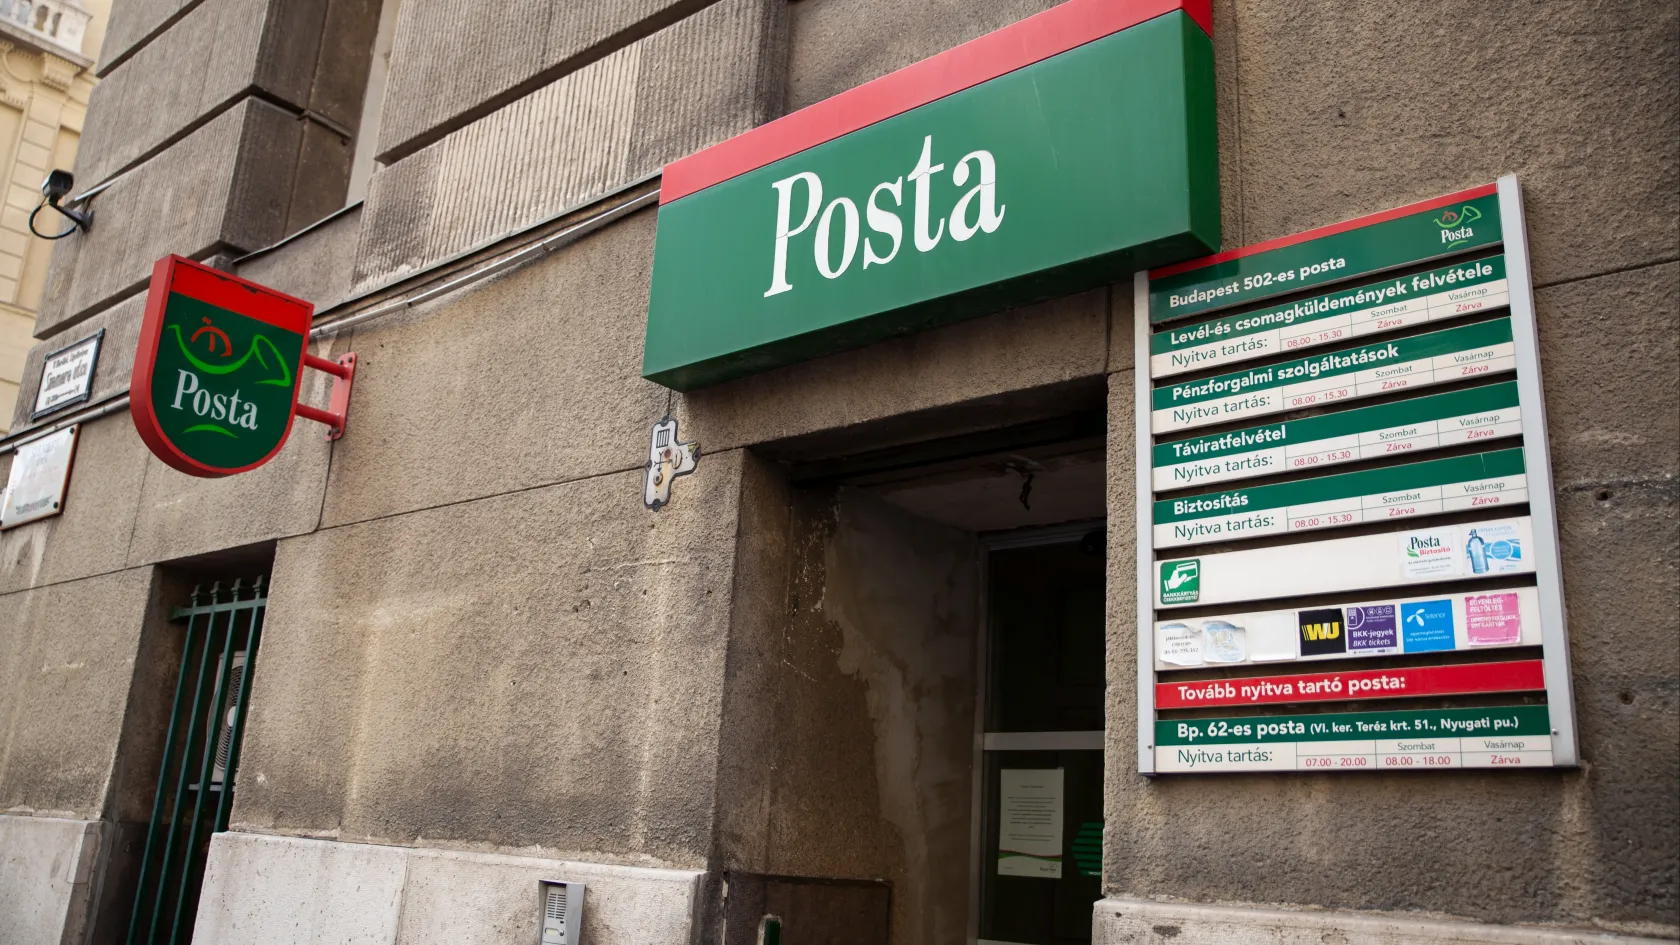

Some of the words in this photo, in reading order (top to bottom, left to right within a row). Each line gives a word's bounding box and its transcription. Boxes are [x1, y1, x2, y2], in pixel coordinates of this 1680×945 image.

[764, 134, 1005, 298] Posta
[1441, 226, 1474, 243] Posta
[1169, 281, 1240, 308] Budapest
[1243, 269, 1295, 290] 502-es
[1300, 256, 1346, 281] posta
[1448, 288, 1488, 301] Vasárnap
[1171, 322, 1231, 345] Levél-és
[1235, 281, 1408, 331] csomagküldemények
[1412, 262, 1493, 291] felvétele
[1455, 302, 1482, 312] Zárva
[1370, 305, 1408, 318] Szombat
[1377, 319, 1403, 329] Zárva
[1287, 337, 1311, 348] 08.00
[1319, 330, 1342, 341] 15.30
[1171, 348, 1217, 368] Nyitva
[1222, 338, 1268, 356] tartás:
[1454, 350, 1494, 363] Vasárnap
[1173, 369, 1273, 400] Pénzforgalmi
[1277, 344, 1399, 380] szolgáltatások
[1375, 365, 1413, 378] Szombat
[1462, 365, 1489, 375] Zárva
[1381, 379, 1407, 390] Zárva
[170, 369, 258, 430] Posta
[1292, 395, 1316, 406] 08.00
[1325, 389, 1348, 400] 15.30
[1173, 405, 1219, 424] Nyitva
[1223, 395, 1271, 414] tartás:
[1459, 414, 1500, 427] Vasárnap
[1379, 428, 1417, 440] Szombat
[1467, 428, 1494, 439] Zárva
[1173, 424, 1287, 457] Táviratfelvétel
[1386, 442, 1412, 452] Zárva
[1294, 455, 1319, 467] 08.00
[1327, 450, 1351, 462] 15.30
[1174, 463, 1221, 482] Nyitva
[1225, 454, 1273, 472] tartás:
[1464, 481, 1505, 493] Vasárnap
[1174, 493, 1249, 515] Biztosítás
[1382, 493, 1421, 504] Szombat
[1472, 496, 1500, 506] Zárva
[1389, 507, 1415, 517] Zárva
[1175, 524, 1222, 540] Nyitva
[1226, 514, 1274, 532] tartás:
[1294, 518, 1319, 529] 08.00
[1328, 514, 1352, 524] 15.30
[1410, 535, 1441, 550] Posta
[1304, 621, 1340, 641] WU
[1352, 628, 1394, 639] BKK-jegyek
[1368, 638, 1391, 646] tickets
[1178, 682, 1236, 700] Tovább
[1241, 681, 1293, 700] nyitva
[1297, 677, 1342, 694] tartó
[1348, 675, 1406, 695] posta:
[1177, 723, 1204, 741] Bp.
[1207, 721, 1251, 737] 62-es
[1257, 720, 1306, 739] posta
[1310, 723, 1329, 735] (VI.
[1332, 722, 1353, 733] ker.
[1356, 721, 1387, 732] Teréz
[1390, 719, 1411, 731] krt.
[1414, 719, 1437, 731] 51.,
[1440, 717, 1490, 732] Nyugati
[1494, 716, 1519, 731] pu.)
[1397, 741, 1435, 751] Szombat
[1484, 740, 1525, 750] Vasárnap
[1178, 749, 1223, 767] Nyitva
[1227, 747, 1273, 762] tartás:
[1305, 758, 1331, 767] 07.00
[1340, 757, 1367, 766] 20.00
[1385, 757, 1413, 766] 08.00
[1423, 756, 1451, 765] 18.00
[1490, 755, 1521, 764] Zárva
